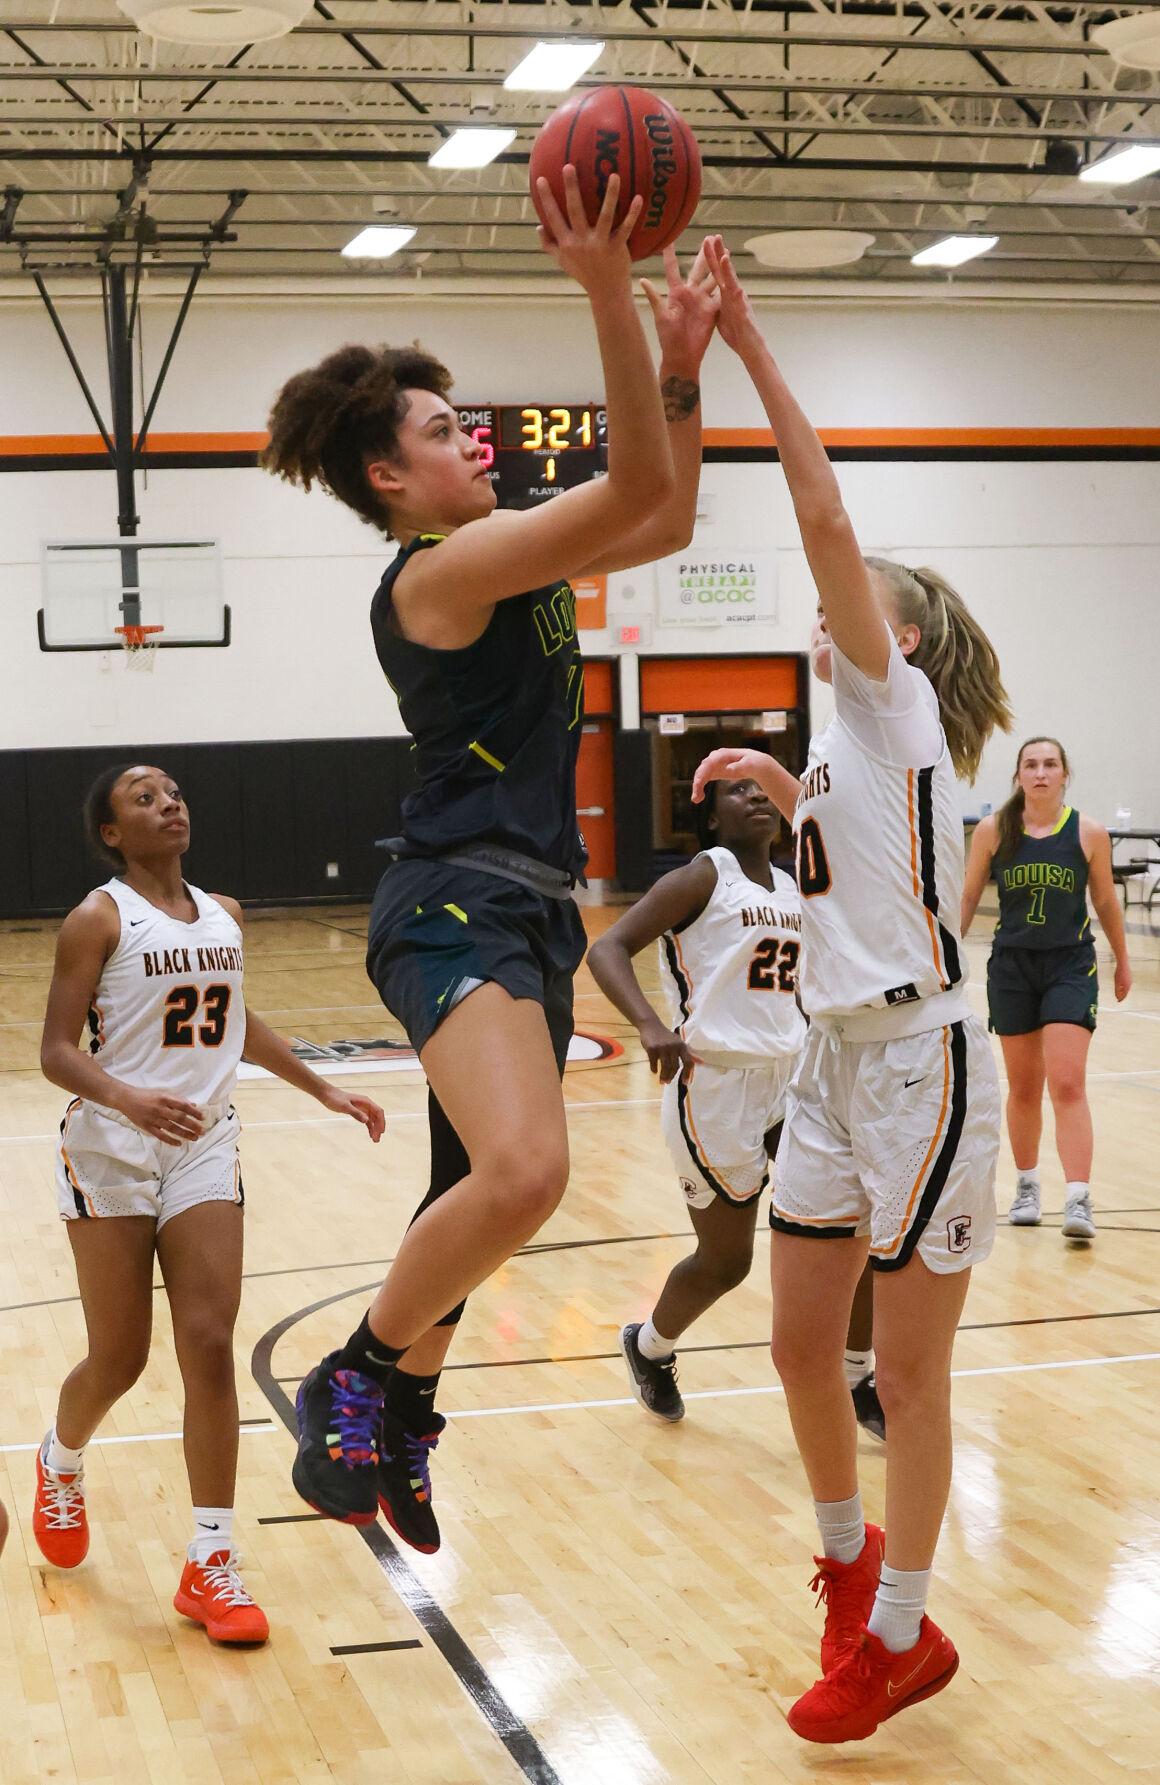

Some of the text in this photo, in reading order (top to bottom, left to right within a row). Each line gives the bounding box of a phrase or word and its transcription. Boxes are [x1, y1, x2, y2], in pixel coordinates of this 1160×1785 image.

[643, 114, 677, 229] Wilson
[459, 411, 492, 426] OME
[680, 563, 756, 575] PHYSICAL
[792, 815, 833, 900] 0
[1004, 862, 1075, 892] LOUISA
[1027, 887, 1046, 925] 1
[143, 948, 192, 978] BLACK
[746, 936, 801, 994] 22
[894, 988, 908, 1000] M
[160, 982, 232, 1049] 23
